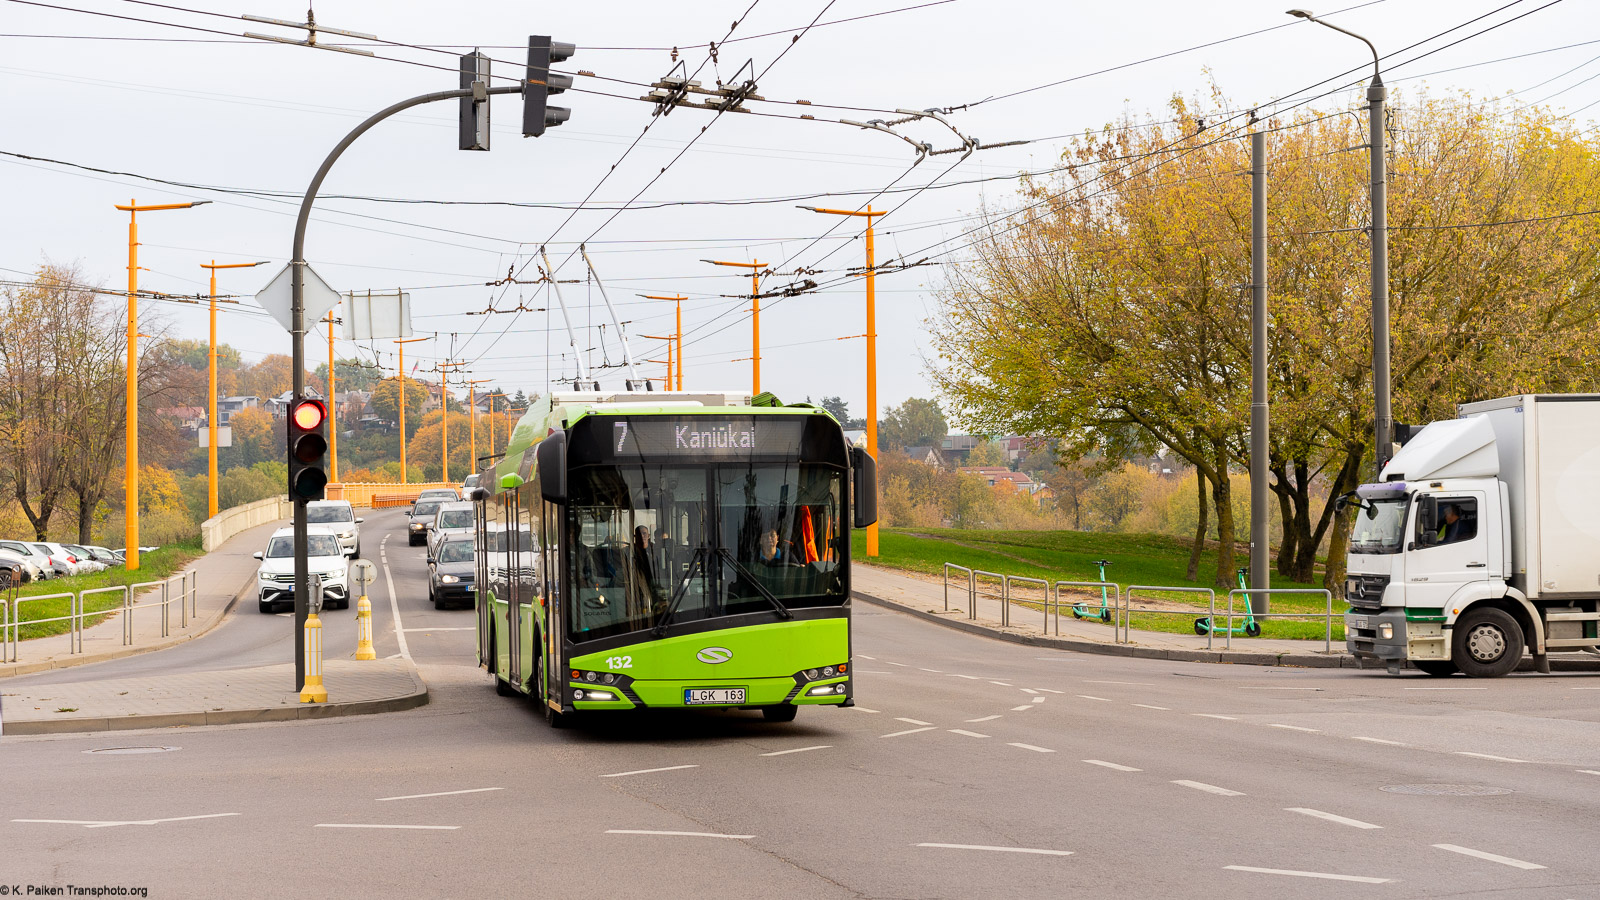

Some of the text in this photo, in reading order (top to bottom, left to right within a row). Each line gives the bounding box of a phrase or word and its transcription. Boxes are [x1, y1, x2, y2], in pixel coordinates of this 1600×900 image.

[614, 421, 755, 452] 7 Kaniūkai
[605, 655, 633, 670] 132
[692, 689, 744, 701] LGK 163
